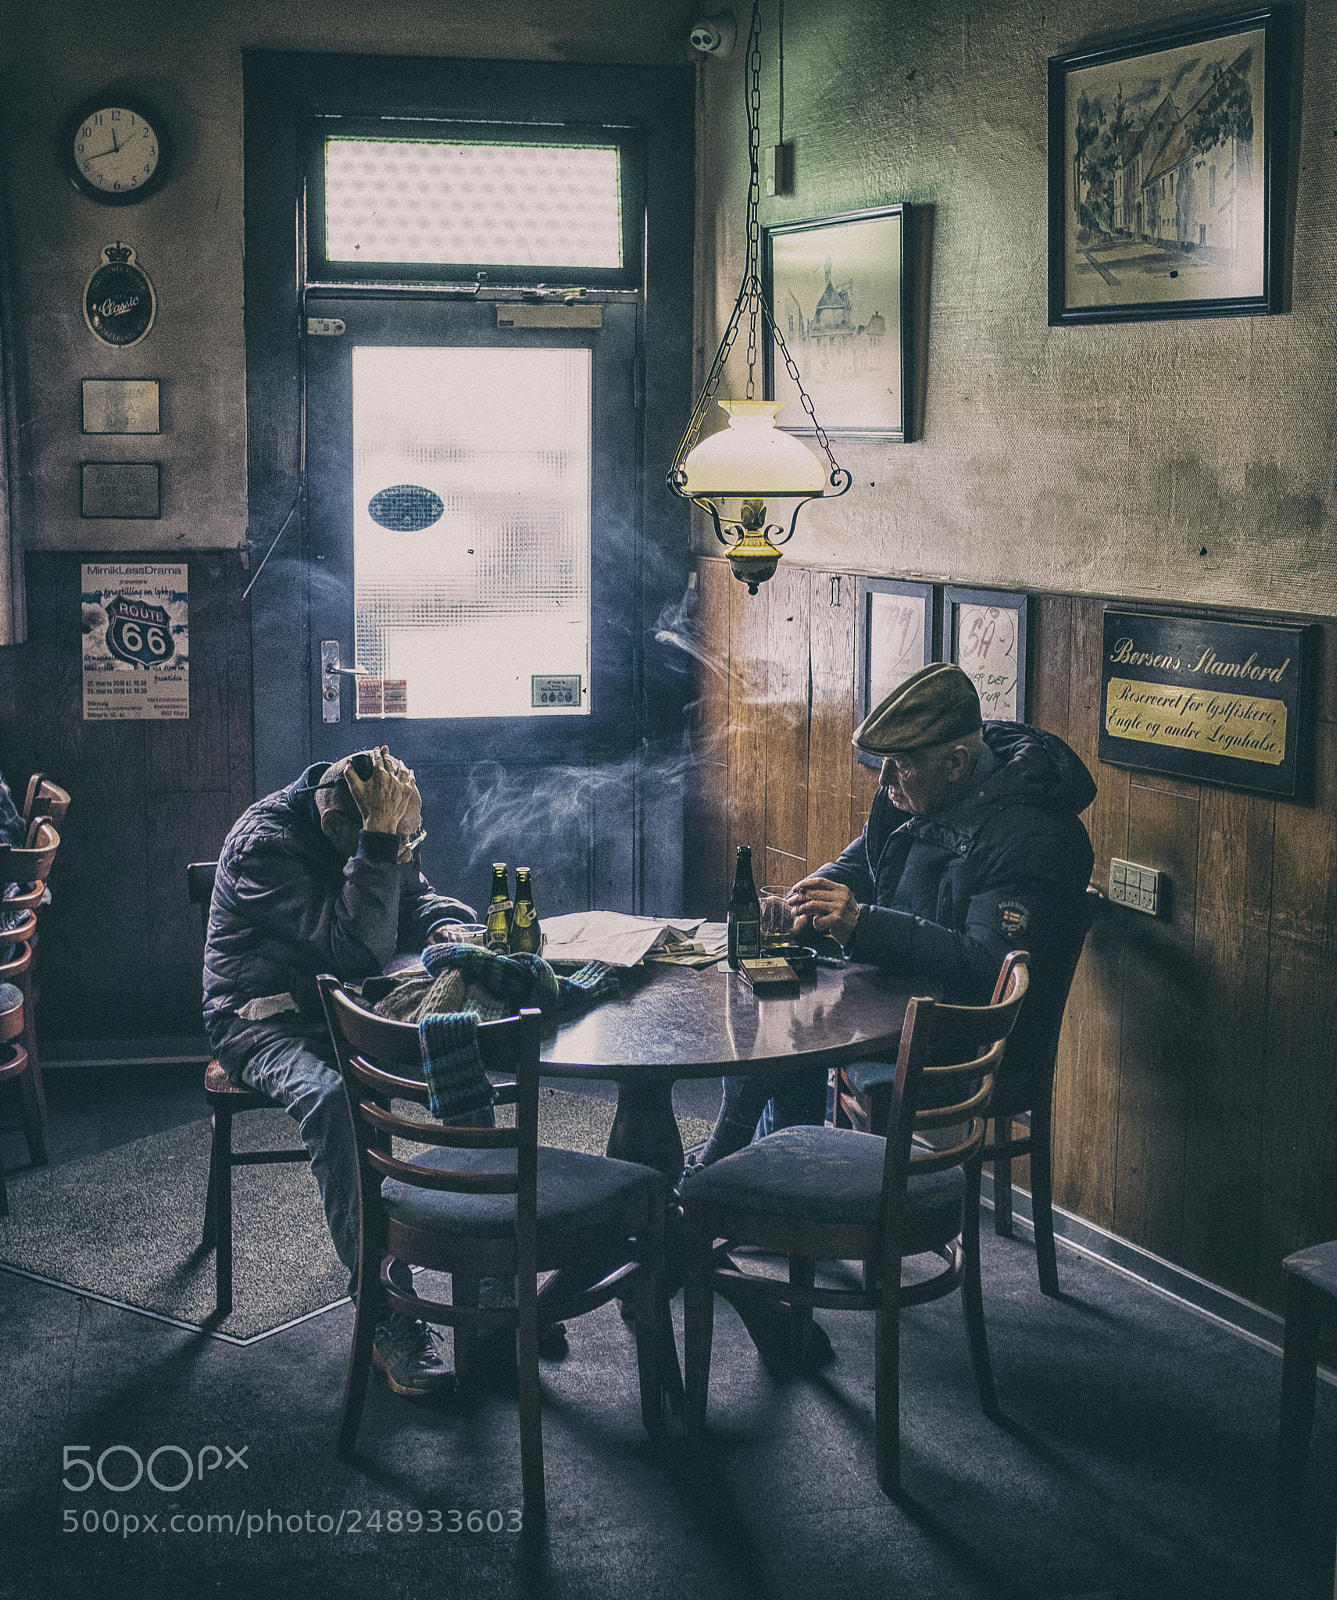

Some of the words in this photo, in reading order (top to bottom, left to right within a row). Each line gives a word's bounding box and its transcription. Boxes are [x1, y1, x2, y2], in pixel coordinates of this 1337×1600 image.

[94, 114, 103, 126] 11
[111, 110, 121, 121] 12
[131, 115, 135, 126] 1
[82, 127, 92, 138] 10
[142, 127, 149, 138] 2
[77, 144, 84, 154] 9
[149, 146, 155, 157] 3
[83, 161, 90, 172] 8
[143, 164, 150, 174] 4
[97, 174, 104, 185] 7
[113, 180, 120, 190] 6
[130, 176, 138, 187] 5
[98, 296, 139, 316] Classic
[119, 602, 164, 622] ROUTE
[122, 622, 166, 655] 66
[1187, 644, 1291, 684] Stambord
[1180, 694, 1203, 716] for
[1108, 705, 1142, 734] Engle
[1145, 721, 1160, 738] og
[1164, 721, 1200, 740] andre
